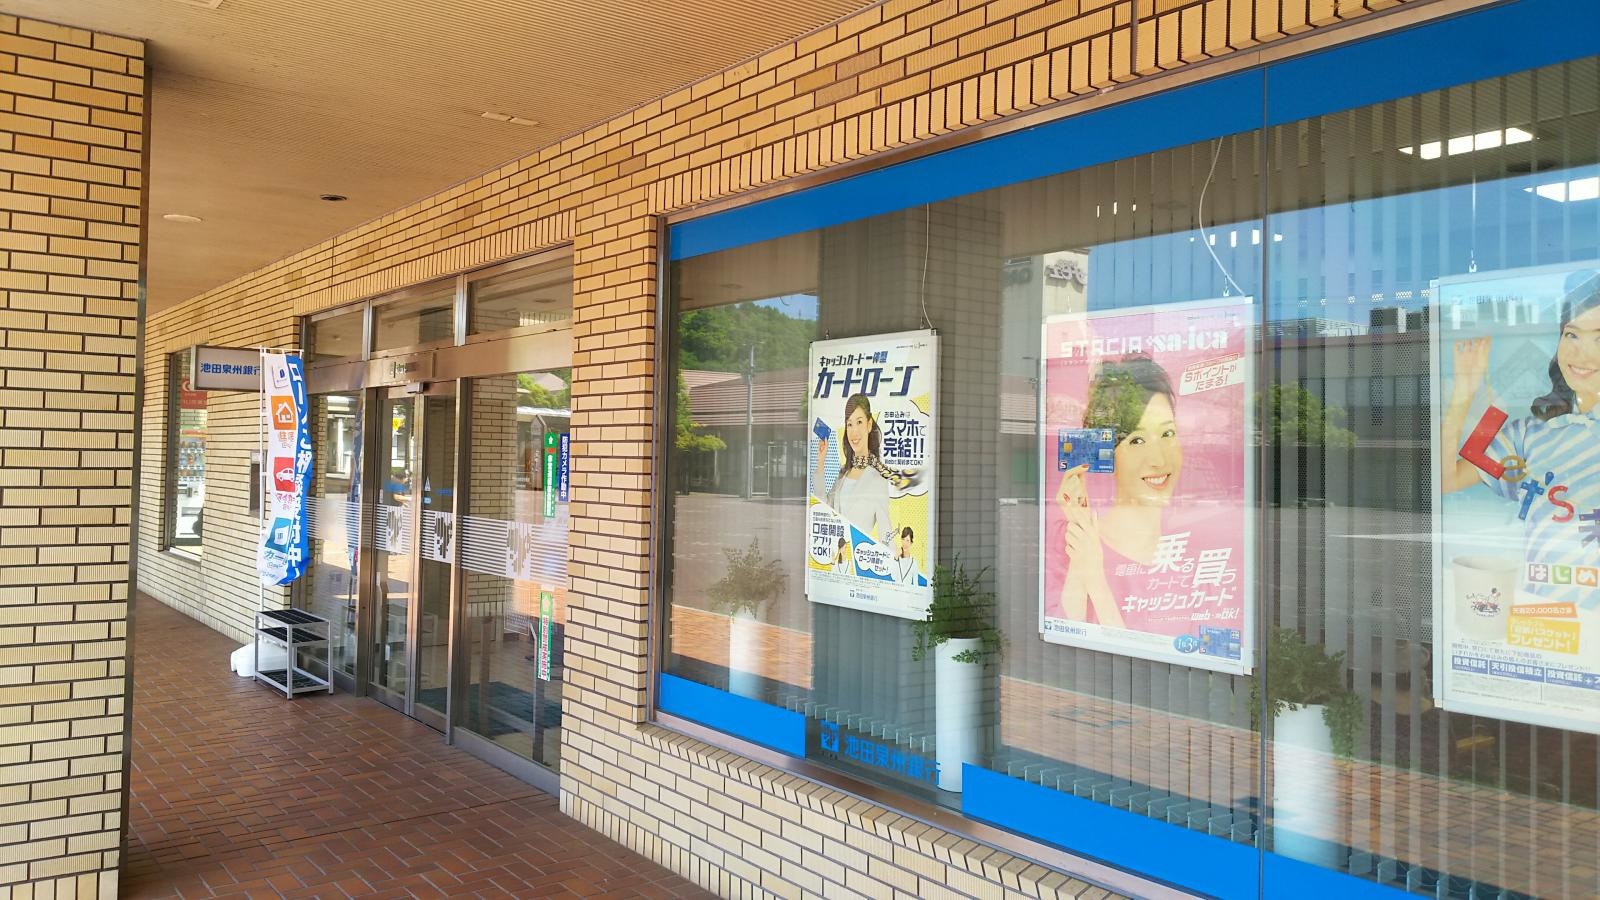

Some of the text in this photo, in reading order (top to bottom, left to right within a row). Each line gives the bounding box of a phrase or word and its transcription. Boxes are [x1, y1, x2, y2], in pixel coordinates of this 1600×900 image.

[819, 350, 888, 367] キャッシュカード一体型
[200, 362, 260, 376] 池田泉州銀行
[1184, 363, 1237, 383] Sポイントが
[813, 365, 920, 399] カードローン
[884, 419, 927, 436] スマホで
[883, 437, 924, 458] 完結!!
[813, 523, 845, 538] 口座開設
[813, 535, 832, 546] アプリ
[844, 732, 941, 786] 池田泉州銀行
